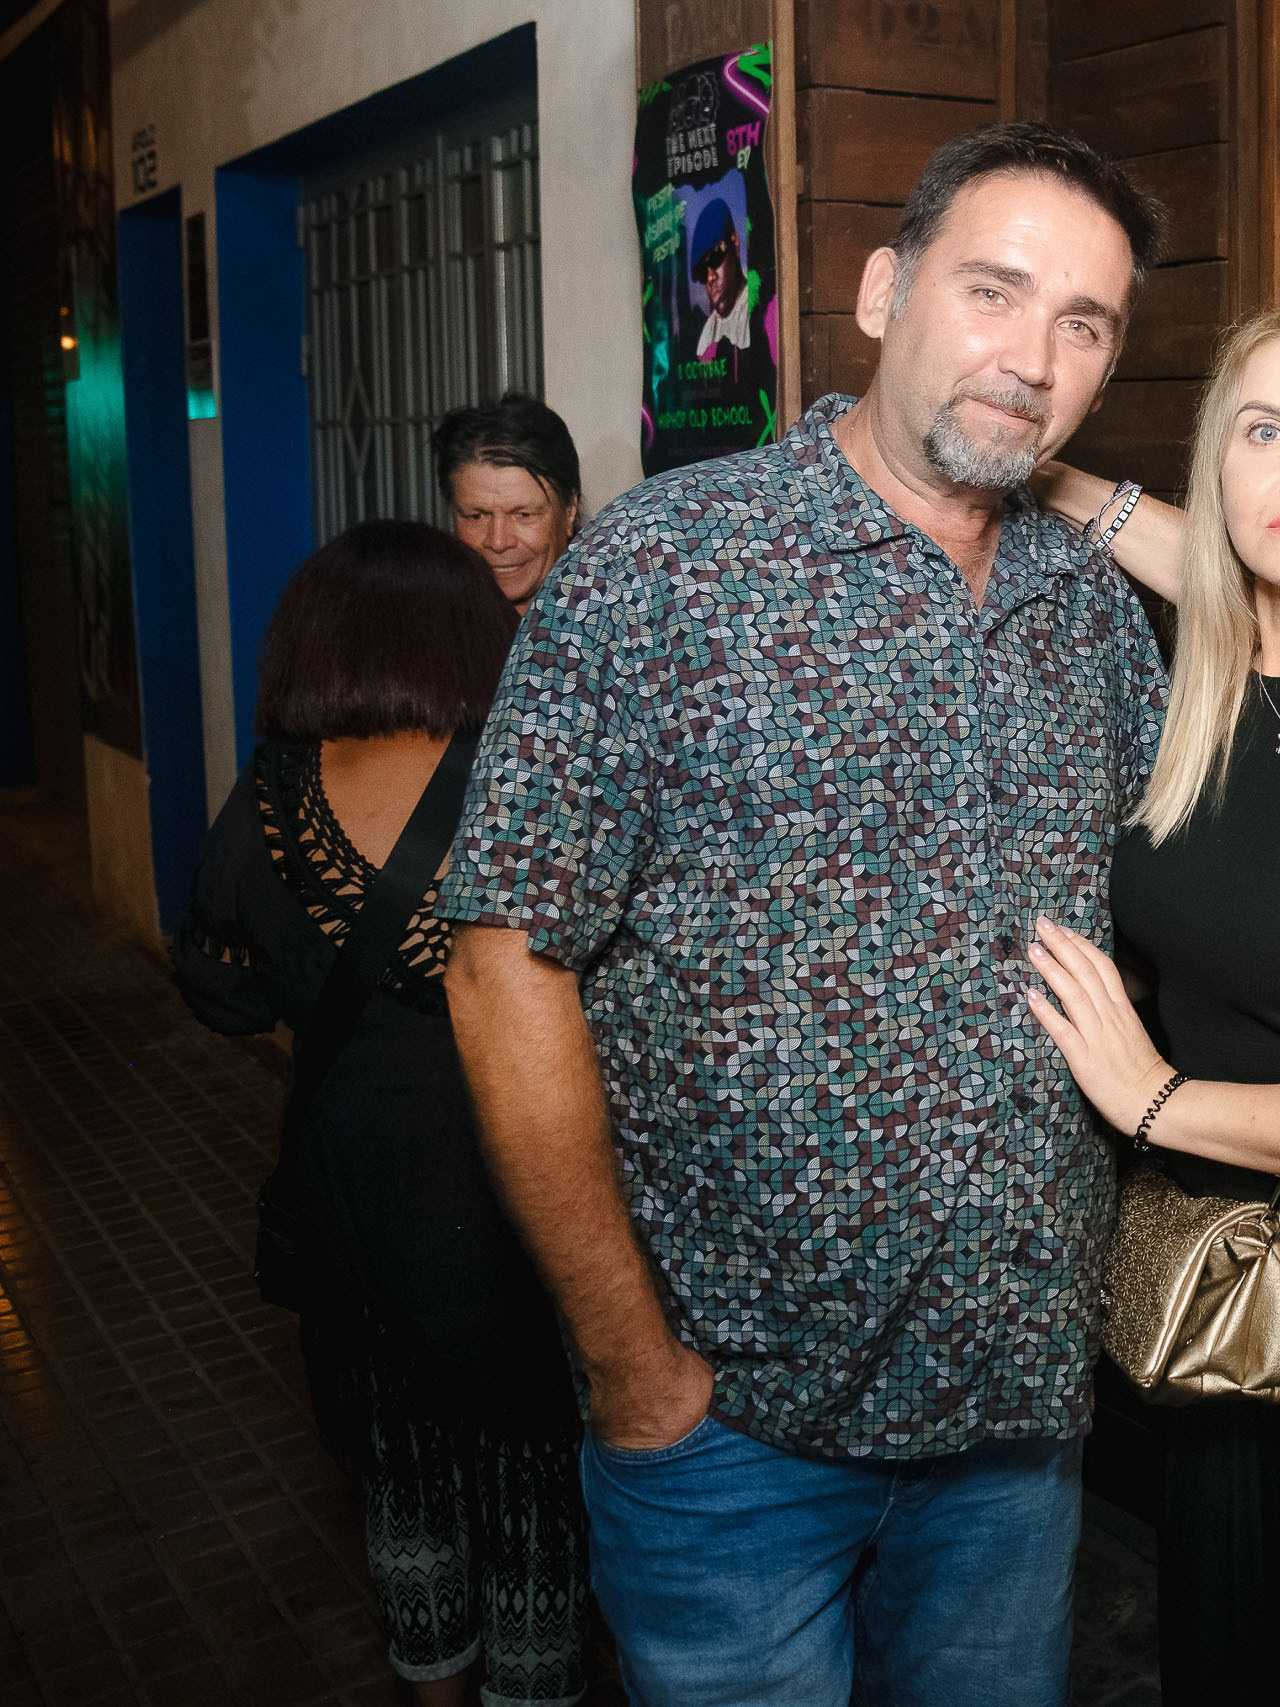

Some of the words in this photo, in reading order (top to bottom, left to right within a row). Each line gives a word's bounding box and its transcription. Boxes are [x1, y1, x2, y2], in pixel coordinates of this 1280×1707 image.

[667, 146, 719, 177] EPISODE
[689, 408, 708, 431] OLD
[711, 405, 752, 428] SCHOOL
